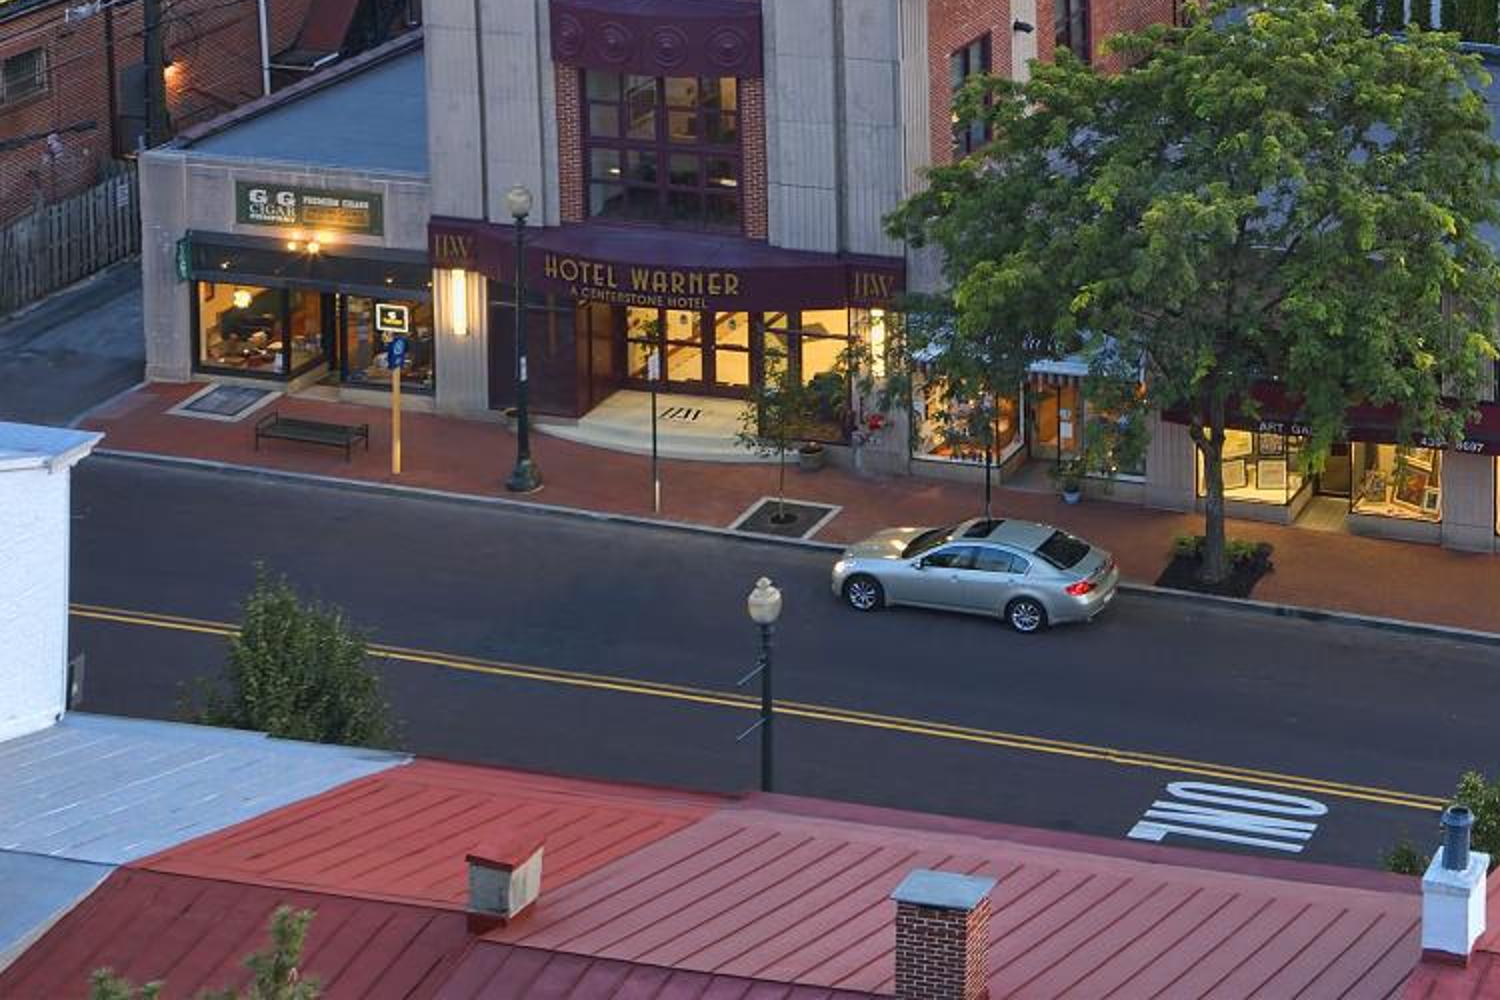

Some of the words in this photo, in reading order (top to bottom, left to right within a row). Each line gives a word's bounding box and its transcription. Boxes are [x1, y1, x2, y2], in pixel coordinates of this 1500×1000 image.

[249, 203, 297, 217] CIGAR
[545, 254, 618, 288] HOTEL
[631, 266, 739, 295] WARNER
